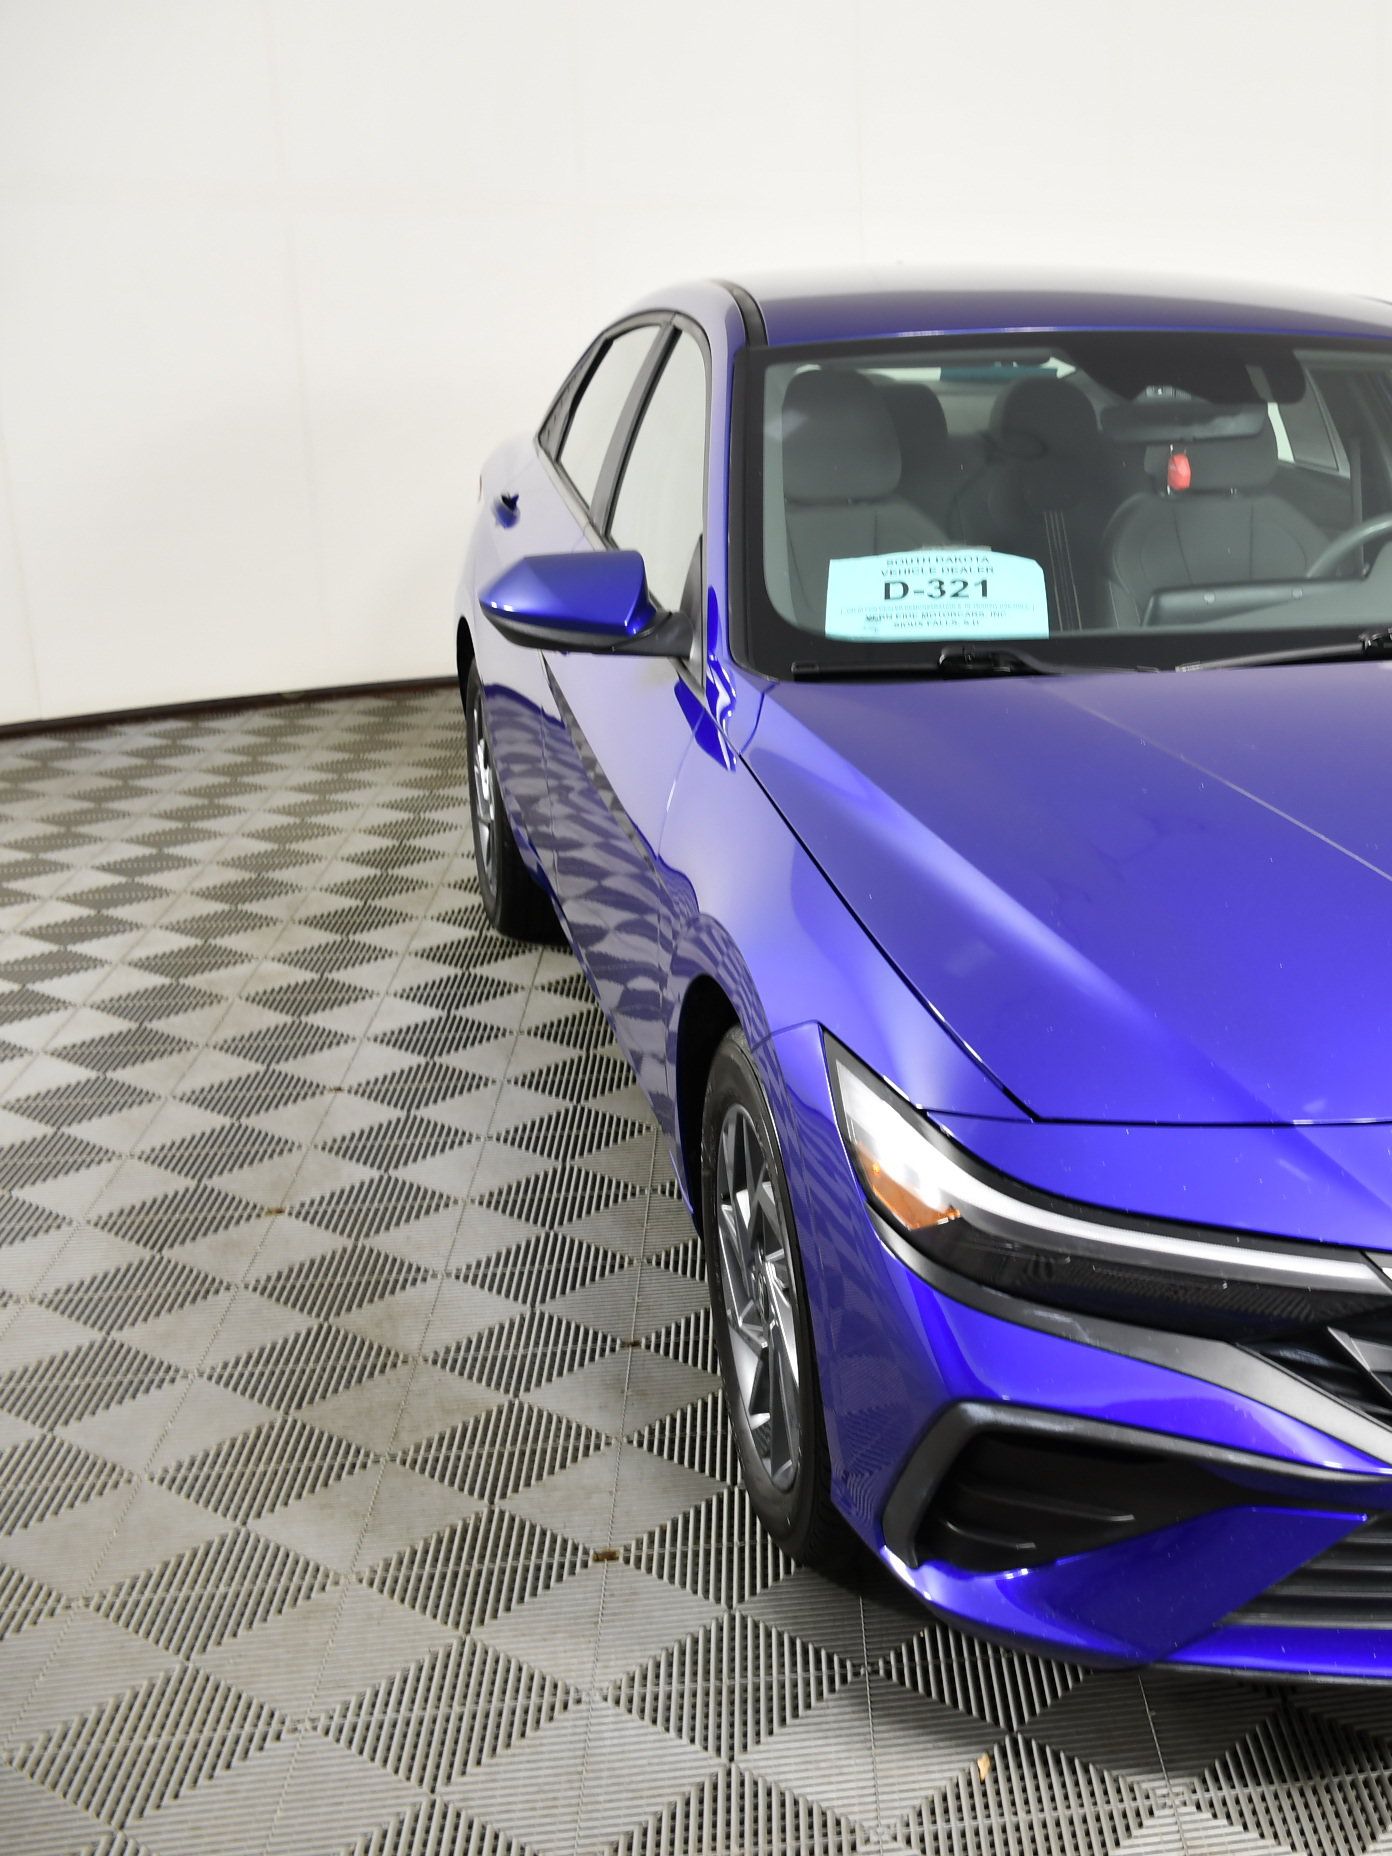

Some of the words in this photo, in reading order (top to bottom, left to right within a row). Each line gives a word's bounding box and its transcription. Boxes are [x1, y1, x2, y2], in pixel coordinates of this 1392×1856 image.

[935, 554, 990, 564] DAKOTA
[881, 566, 937, 577] VEHICLE
[941, 566, 995, 574] DEALER
[883, 577, 989, 601] D-321
